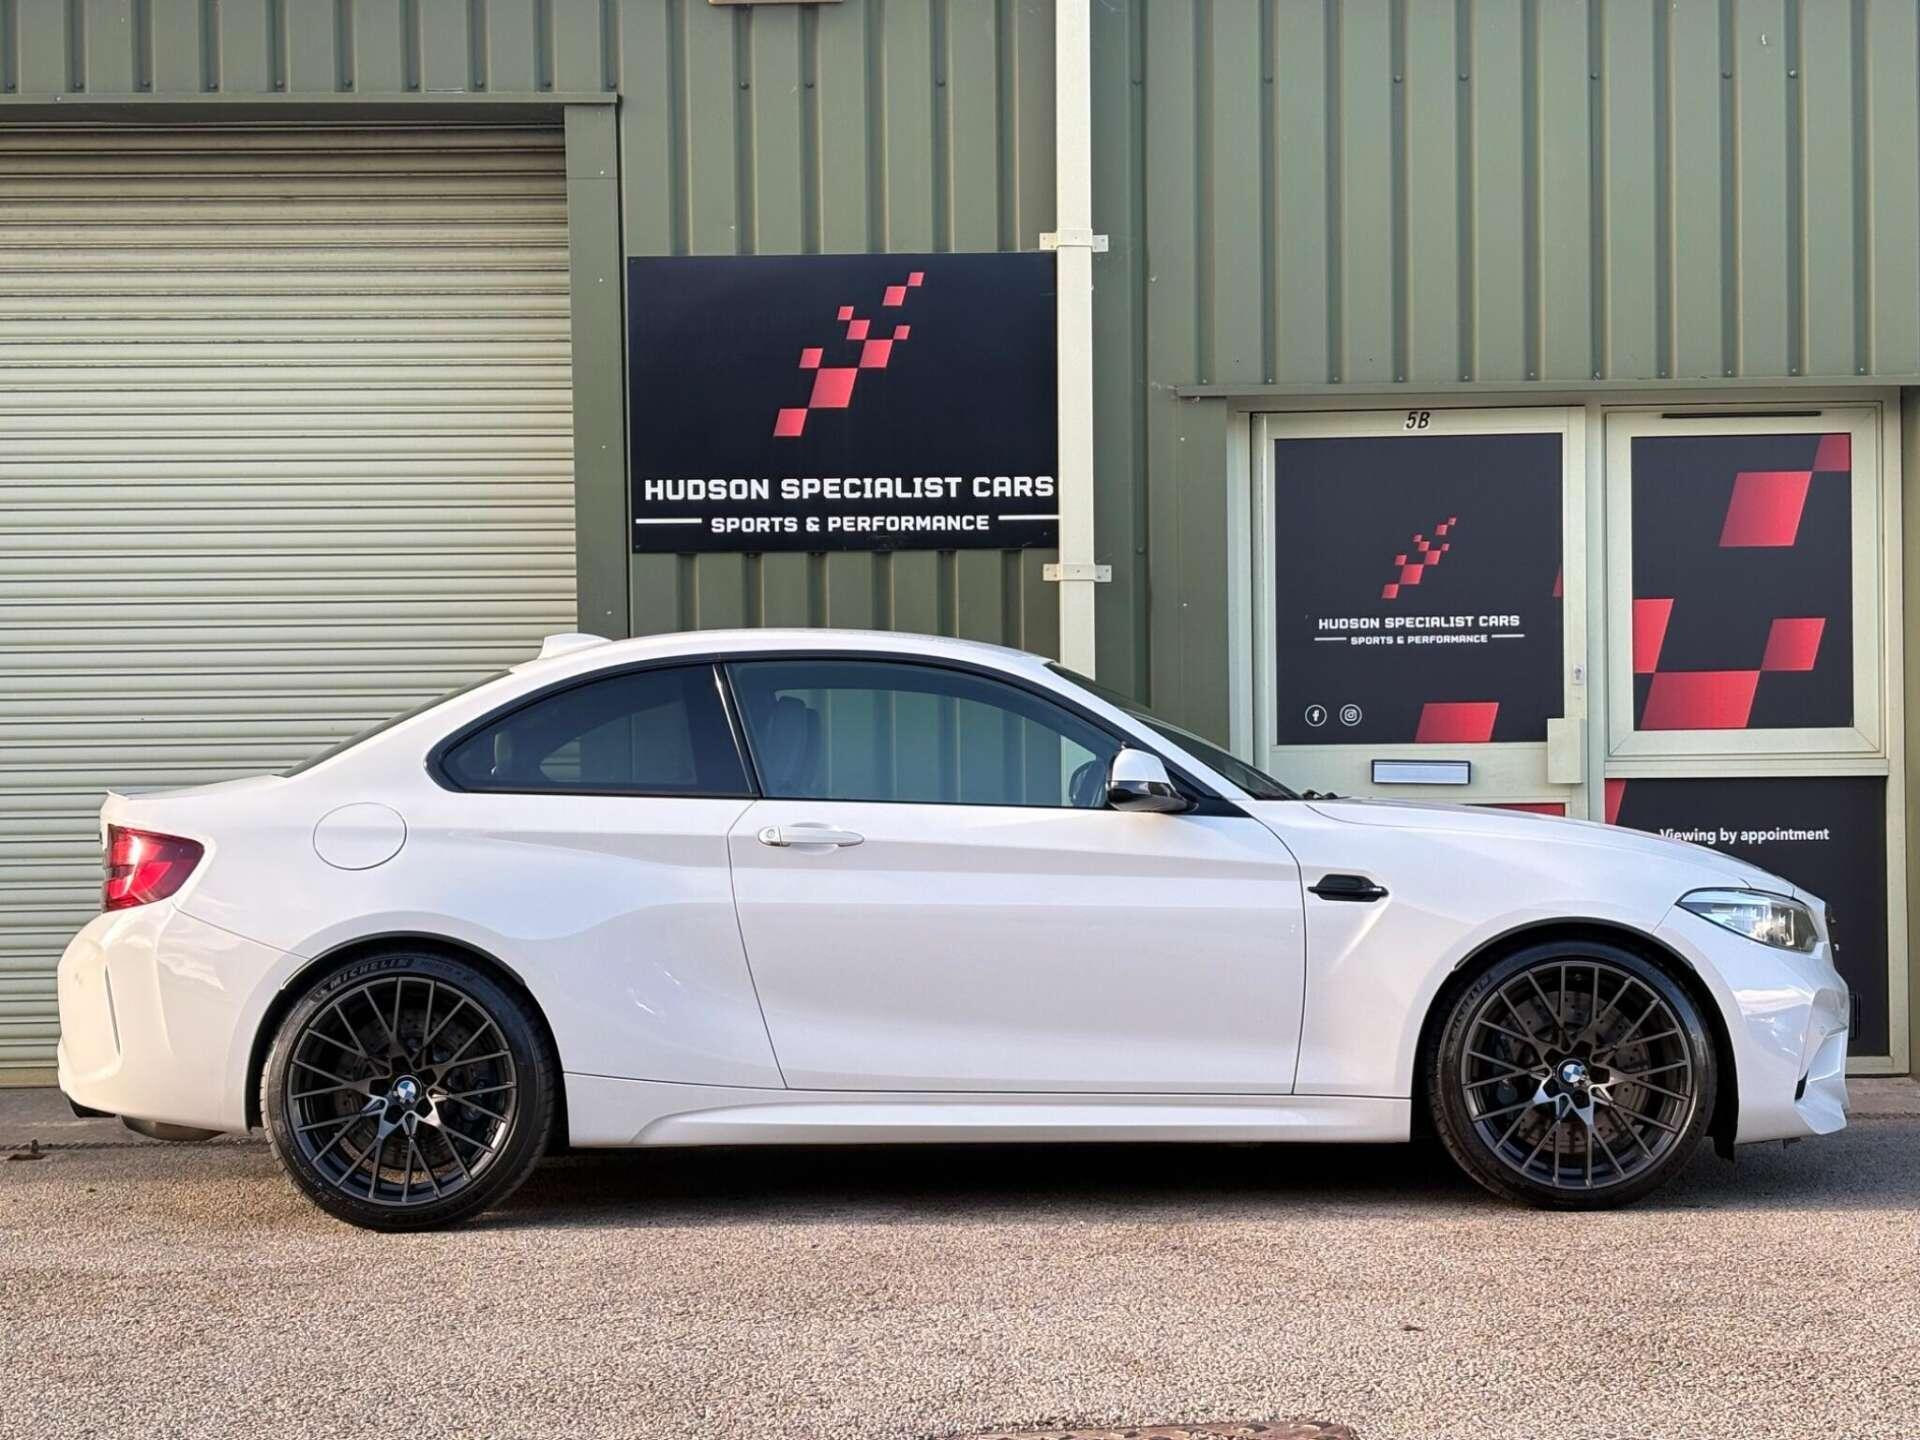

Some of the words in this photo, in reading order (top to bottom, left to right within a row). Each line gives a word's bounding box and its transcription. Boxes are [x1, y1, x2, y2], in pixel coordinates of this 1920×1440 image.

[1406, 411, 1430, 429] 5B
[644, 478, 770, 501] HUDSON
[780, 476, 963, 500] SPECIALIST
[972, 475, 1054, 498] CARS
[711, 516, 798, 533] SPORTS
[805, 516, 820, 532] &
[827, 514, 990, 532] PERFORMANCE
[1318, 617, 1380, 630] HUDSON
[1384, 615, 1475, 629] SPECIALIST
[1478, 614, 1521, 628] CARS
[1350, 635, 1394, 646] SPORTS
[1396, 635, 1405, 645] &
[1407, 634, 1489, 645] PERFORMANCE
[1659, 828, 1717, 845] Viewing
[1719, 827, 1738, 845] by
[1740, 826, 1830, 845] appointment
[329, 958, 410, 989] MICHELIN
